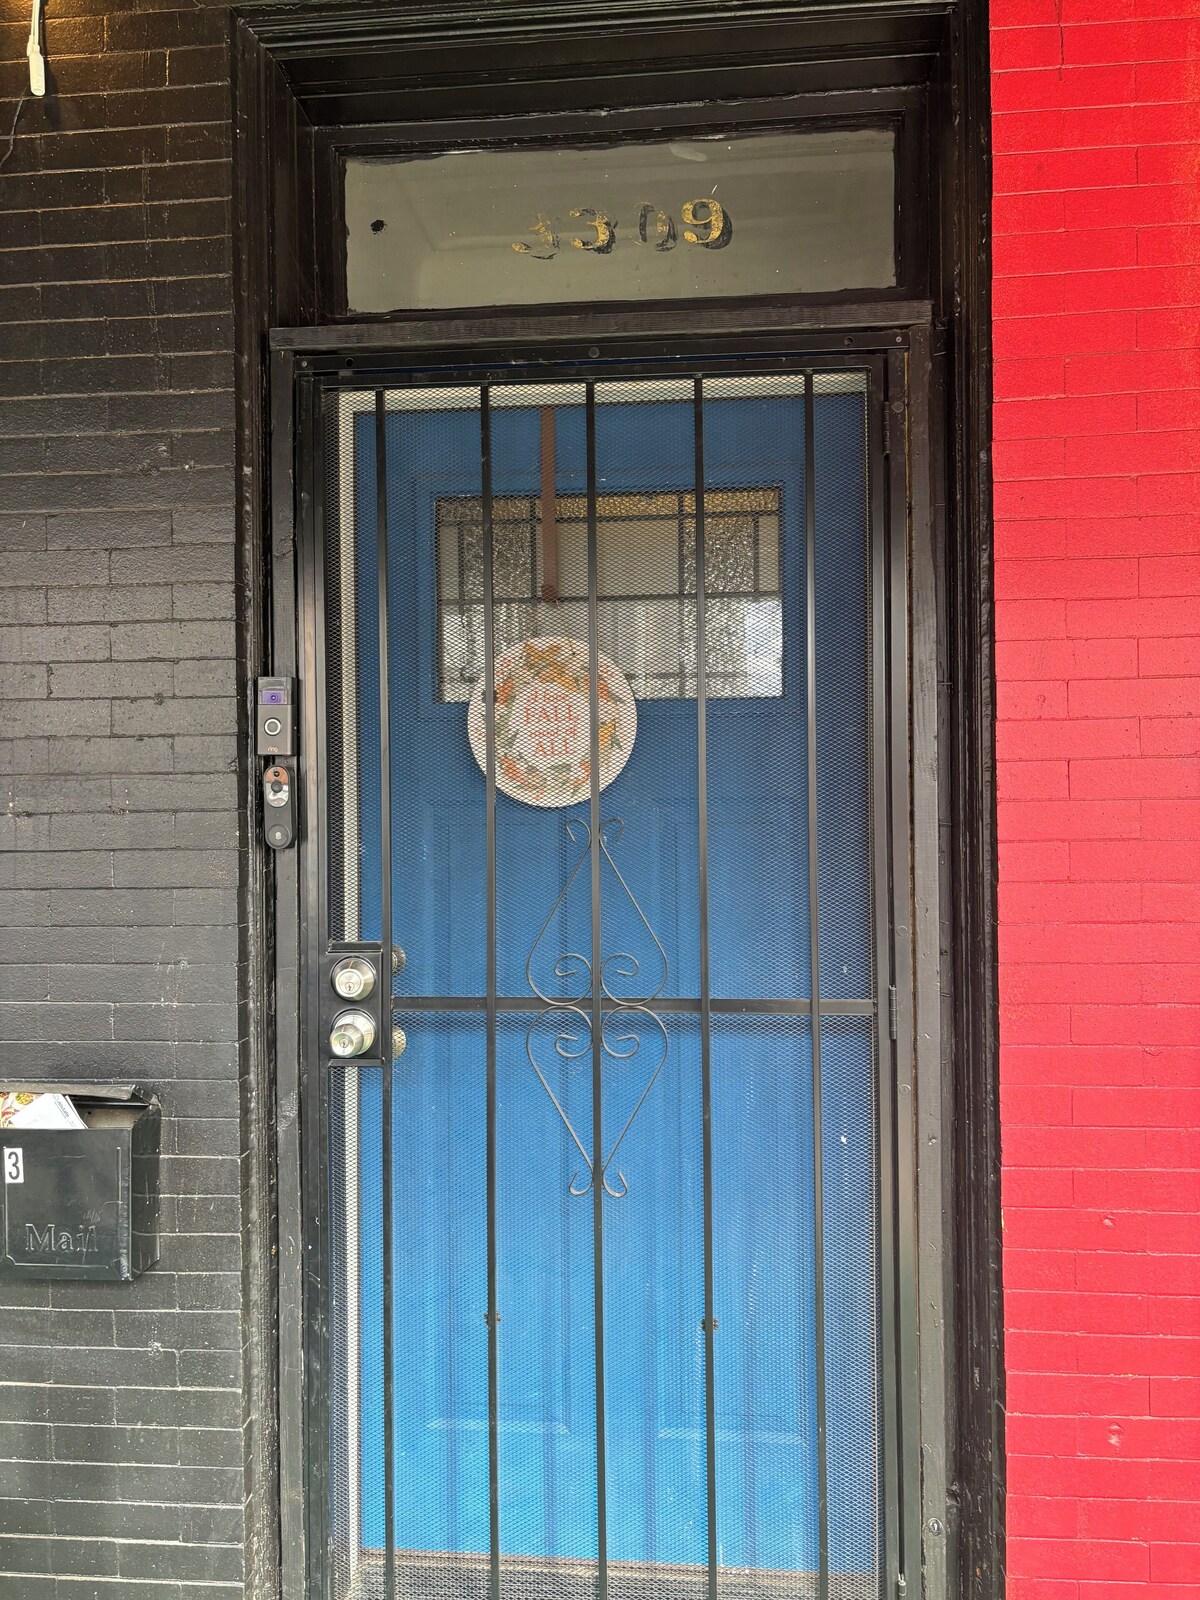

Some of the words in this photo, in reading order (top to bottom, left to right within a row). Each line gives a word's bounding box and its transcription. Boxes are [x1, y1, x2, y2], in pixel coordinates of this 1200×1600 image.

[523, 704, 580, 725] FALL
[532, 738, 576, 758] ALL
[8, 1151, 20, 1180] 3
[25, 1223, 98, 1252] Mail
